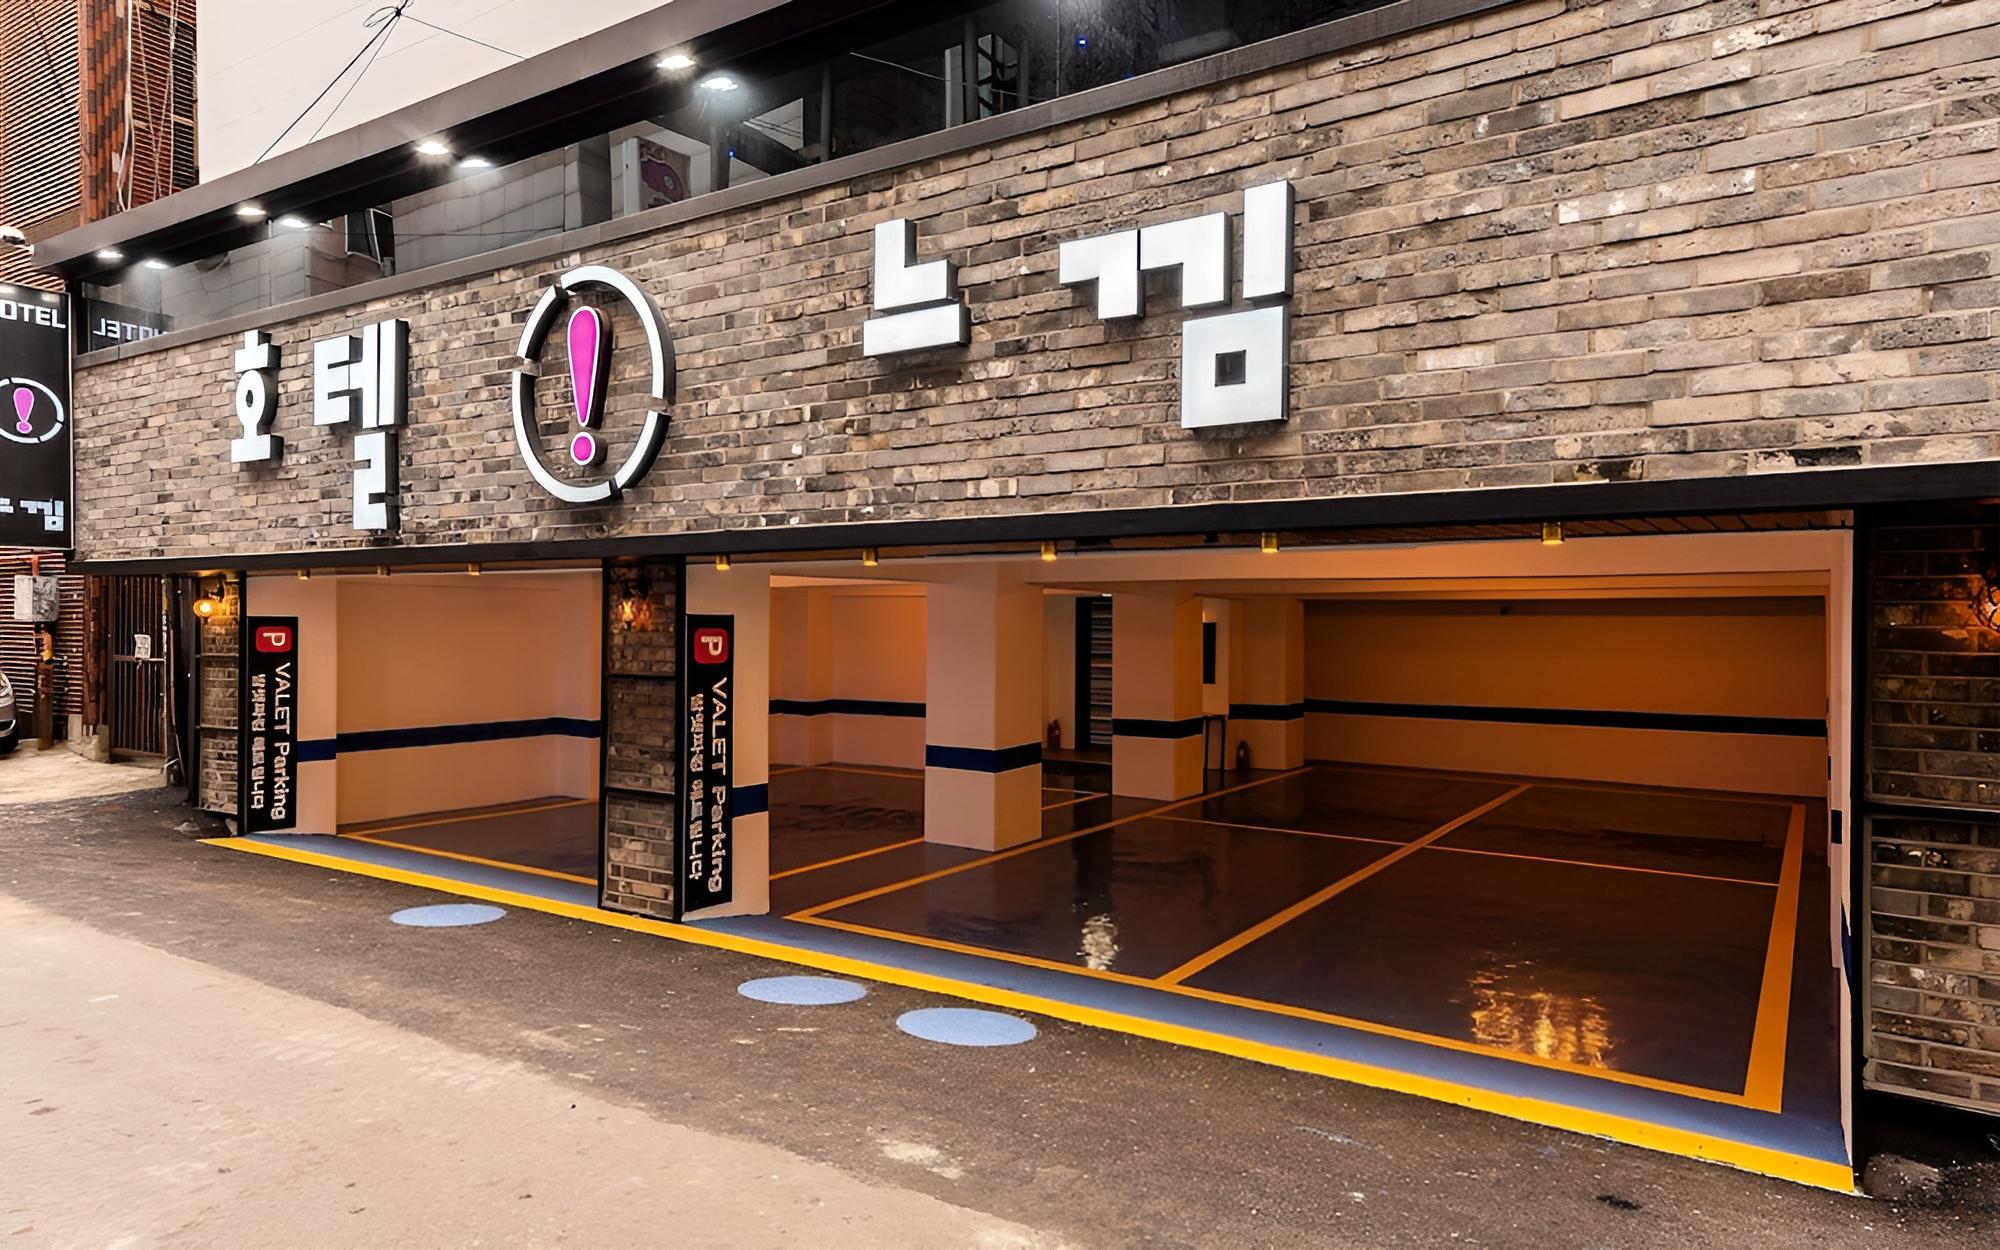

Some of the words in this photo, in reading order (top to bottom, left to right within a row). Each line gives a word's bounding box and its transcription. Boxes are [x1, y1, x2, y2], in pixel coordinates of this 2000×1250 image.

[0, 299, 66, 329] OTEL
[231, 318, 408, 532] 호텔
[862, 179, 1293, 429] 느낌
[262, 632, 286, 647] P
[701, 636, 723, 656] P
[274, 661, 291, 735] VALET
[711, 676, 728, 776] VALET
[270, 742, 290, 820] Parking
[707, 785, 726, 893] Parking
